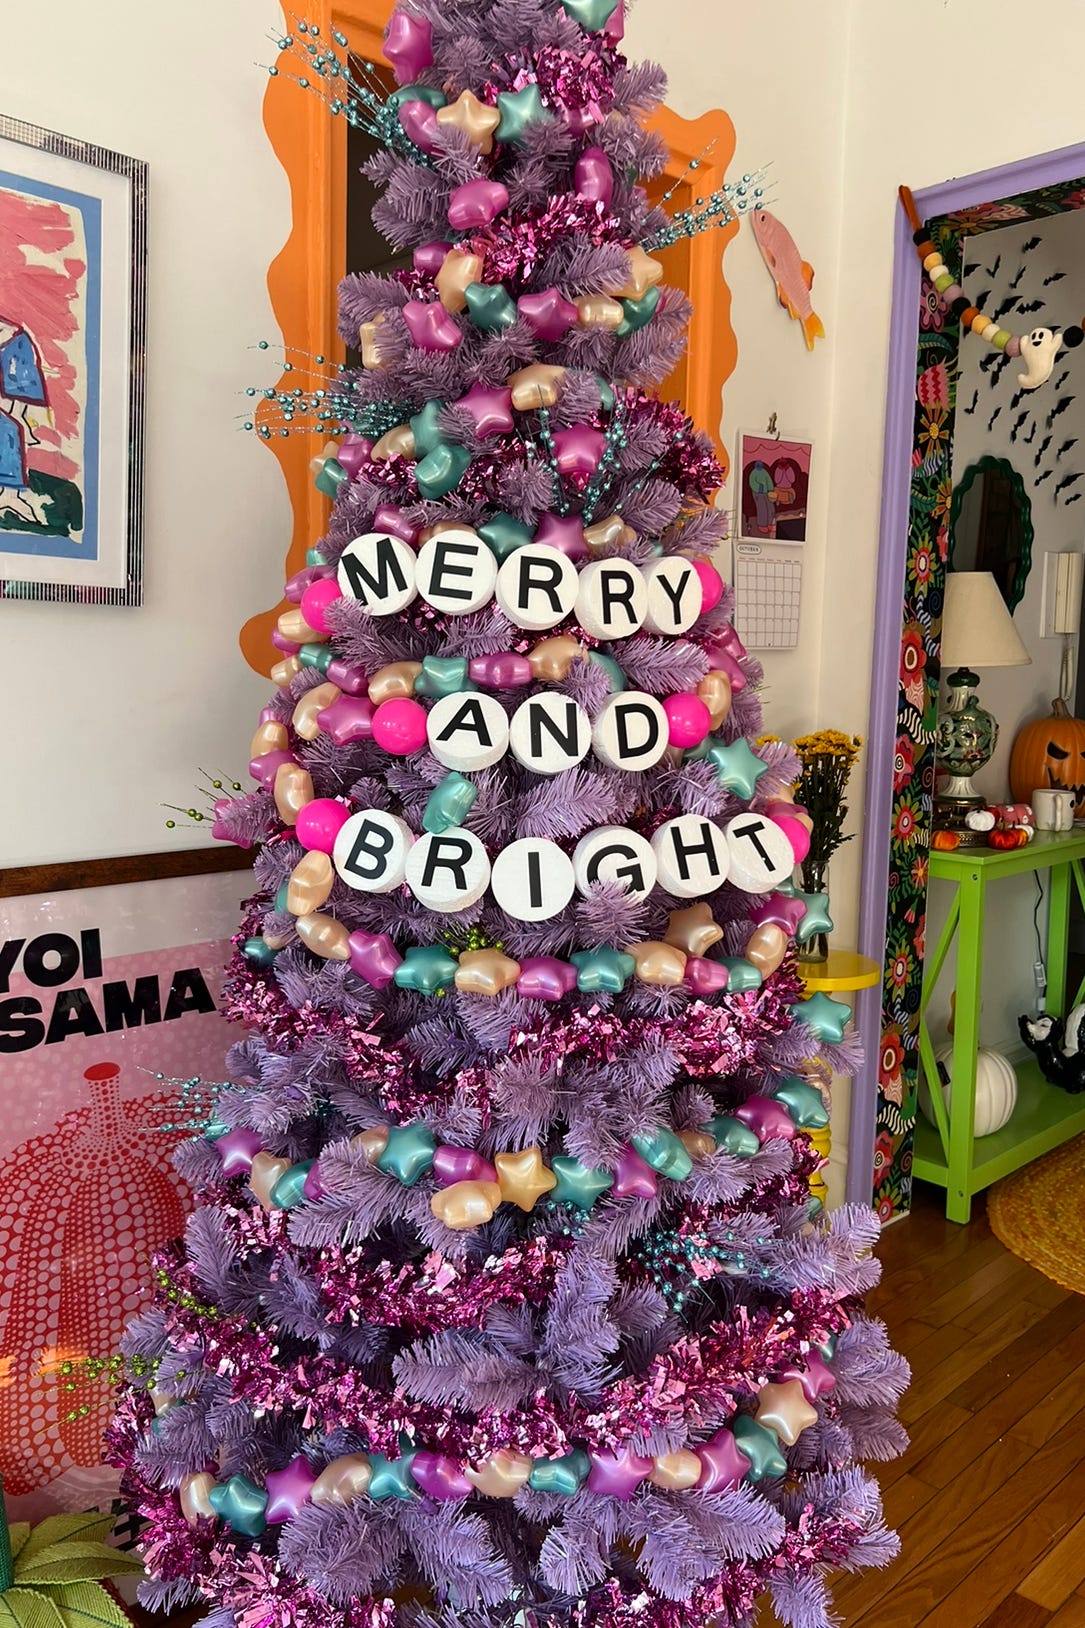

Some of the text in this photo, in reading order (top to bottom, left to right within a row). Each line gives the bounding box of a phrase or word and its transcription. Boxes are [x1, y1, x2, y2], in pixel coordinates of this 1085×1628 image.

[341, 537, 692, 626] MERRY
[436, 698, 659, 759] AND
[344, 819, 781, 908] BRIGHT
[0, 968, 217, 1054] SAMA
